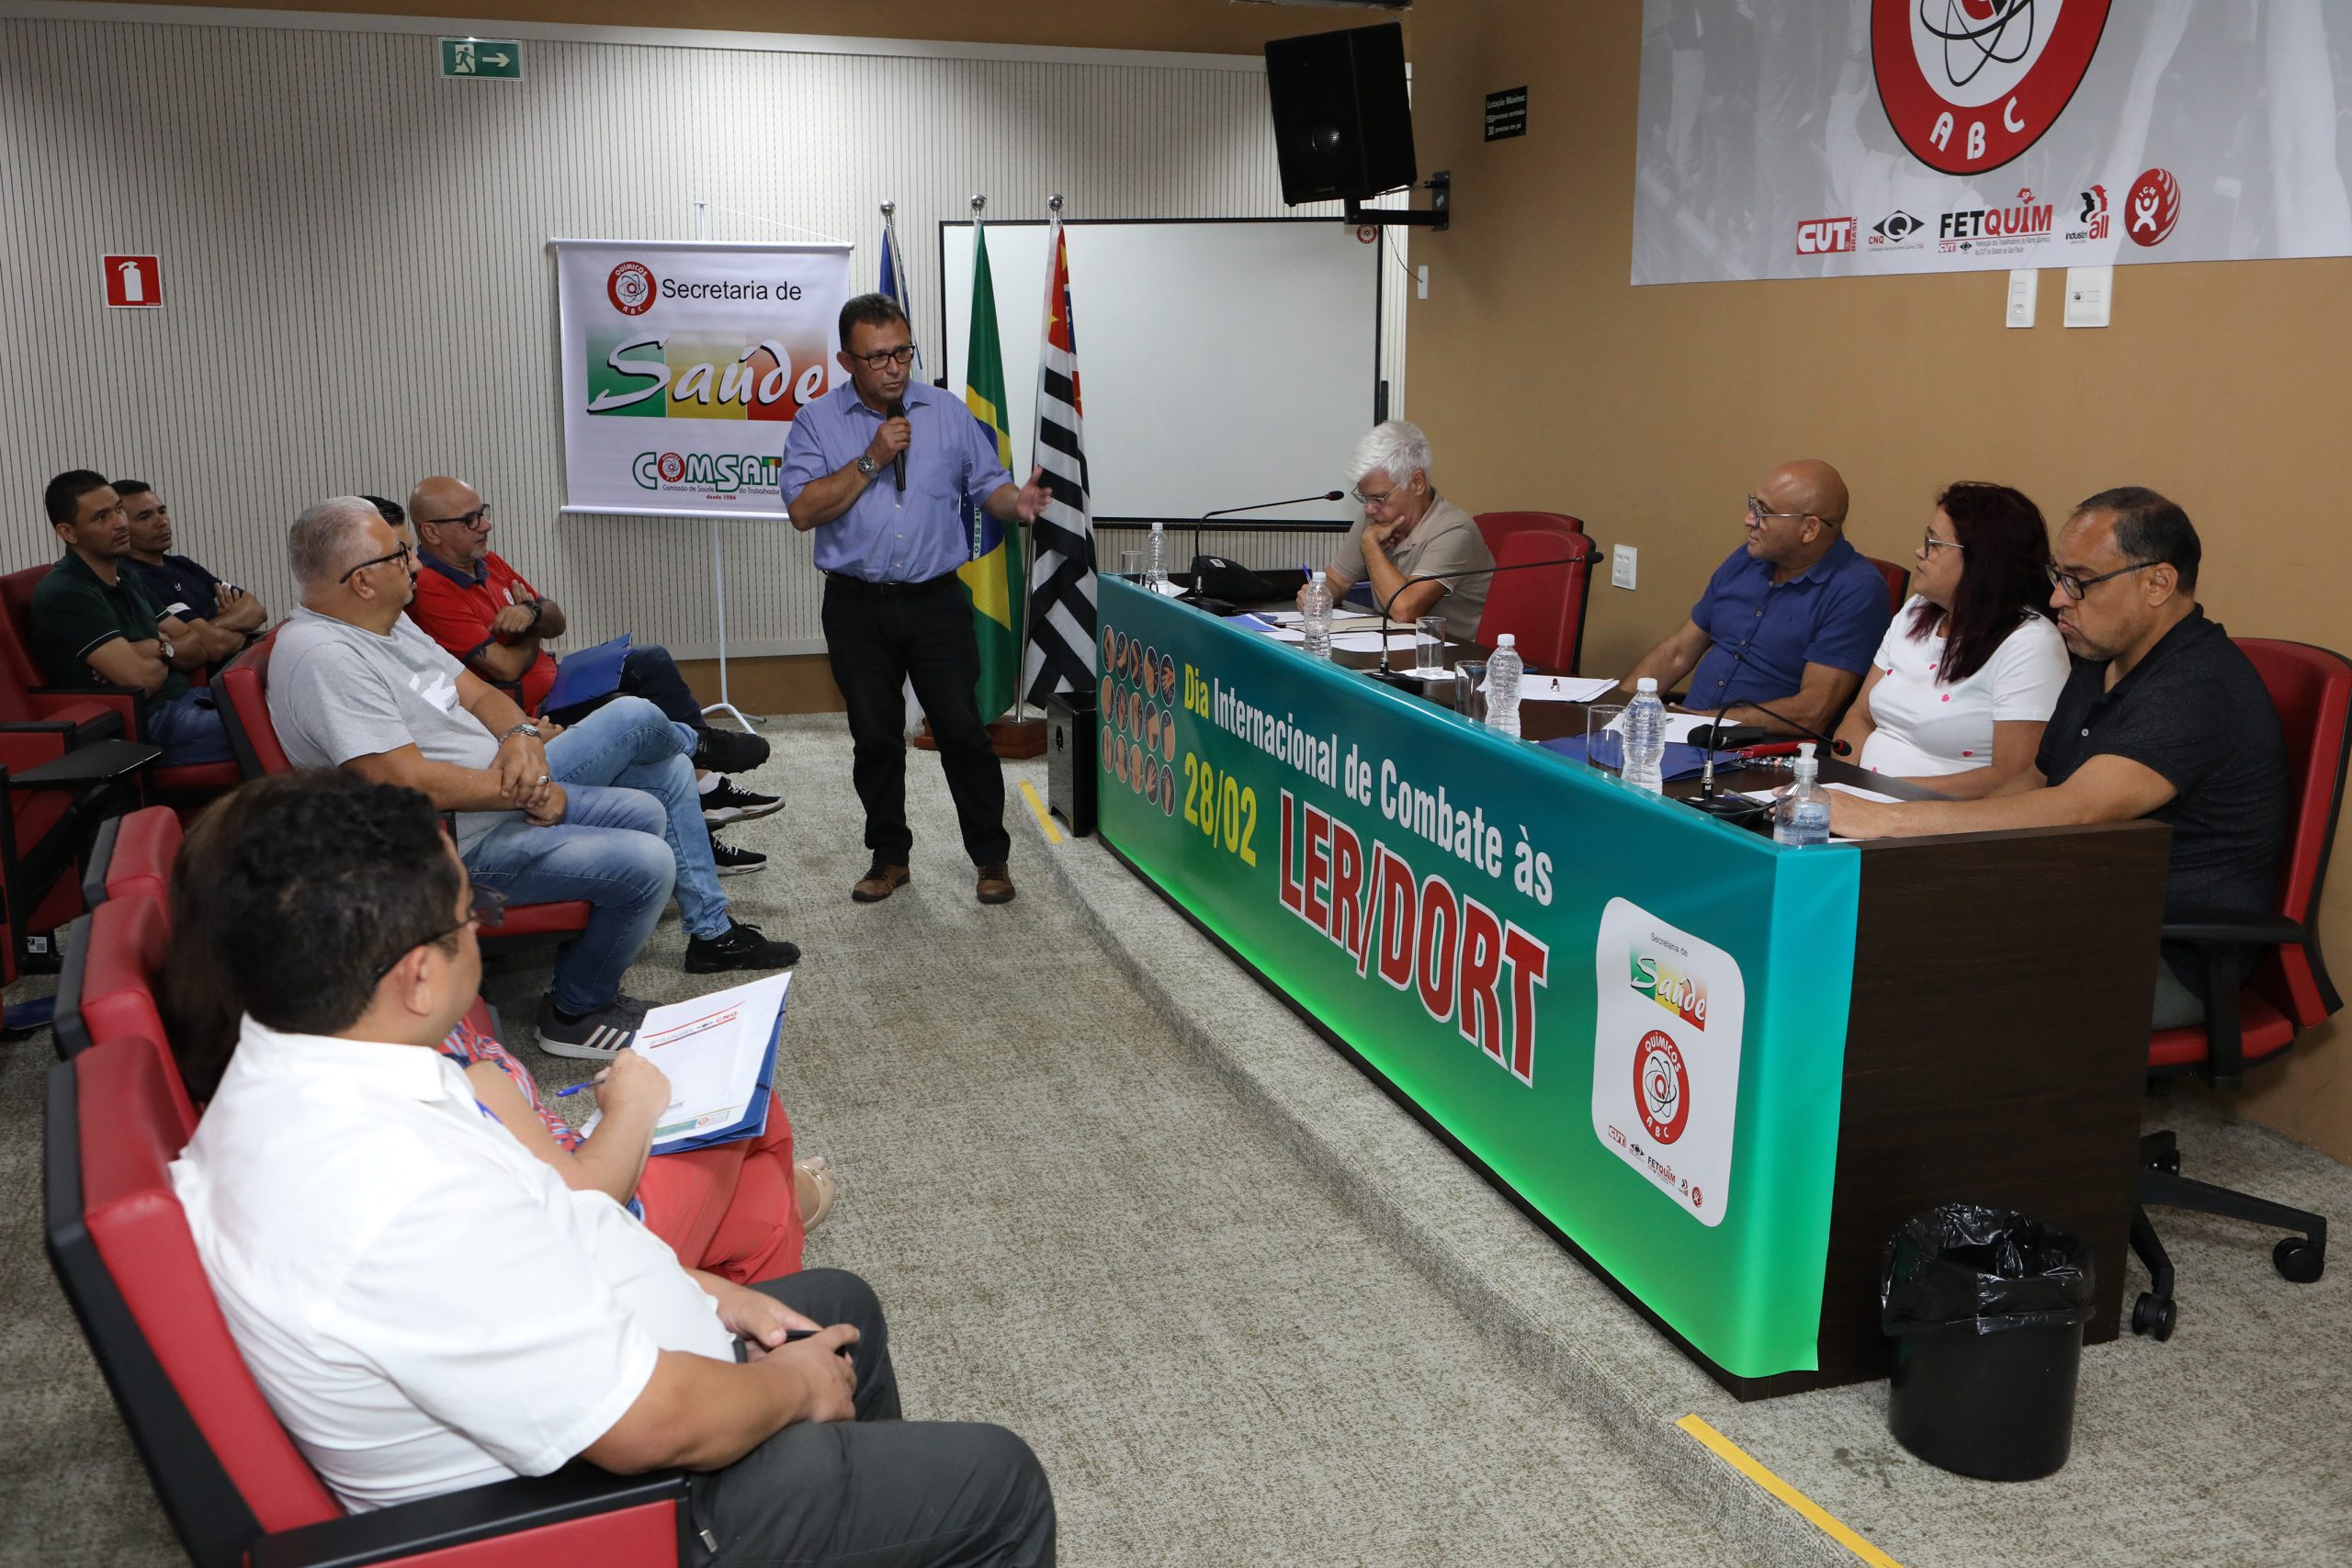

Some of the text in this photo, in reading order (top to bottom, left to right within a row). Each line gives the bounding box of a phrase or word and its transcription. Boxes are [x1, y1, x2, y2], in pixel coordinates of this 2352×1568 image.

[1929, 96, 2025, 160] ABC
[1798, 221, 1850, 253] CUT
[1868, 236, 1884, 244] CNQ
[662, 278, 802, 301] Secretaria de
[586, 332, 825, 413] Saúde
[662, 483, 688, 492] Comissão
[689, 484, 696, 492] de
[697, 484, 715, 493] Saúde
[748, 486, 780, 495] Trabalhador
[1184, 662, 1553, 907] Dia Internacional de Combate às
[1184, 751, 1257, 868] 28/02
[1279, 786, 1551, 1089] LER/DORT
[1650, 932, 1689, 957] Secretaria de
[1630, 955, 1706, 1022] Saúde
[1645, 1032, 1681, 1073] QUÍMICOS
[1646, 1116, 1669, 1138] ABC
